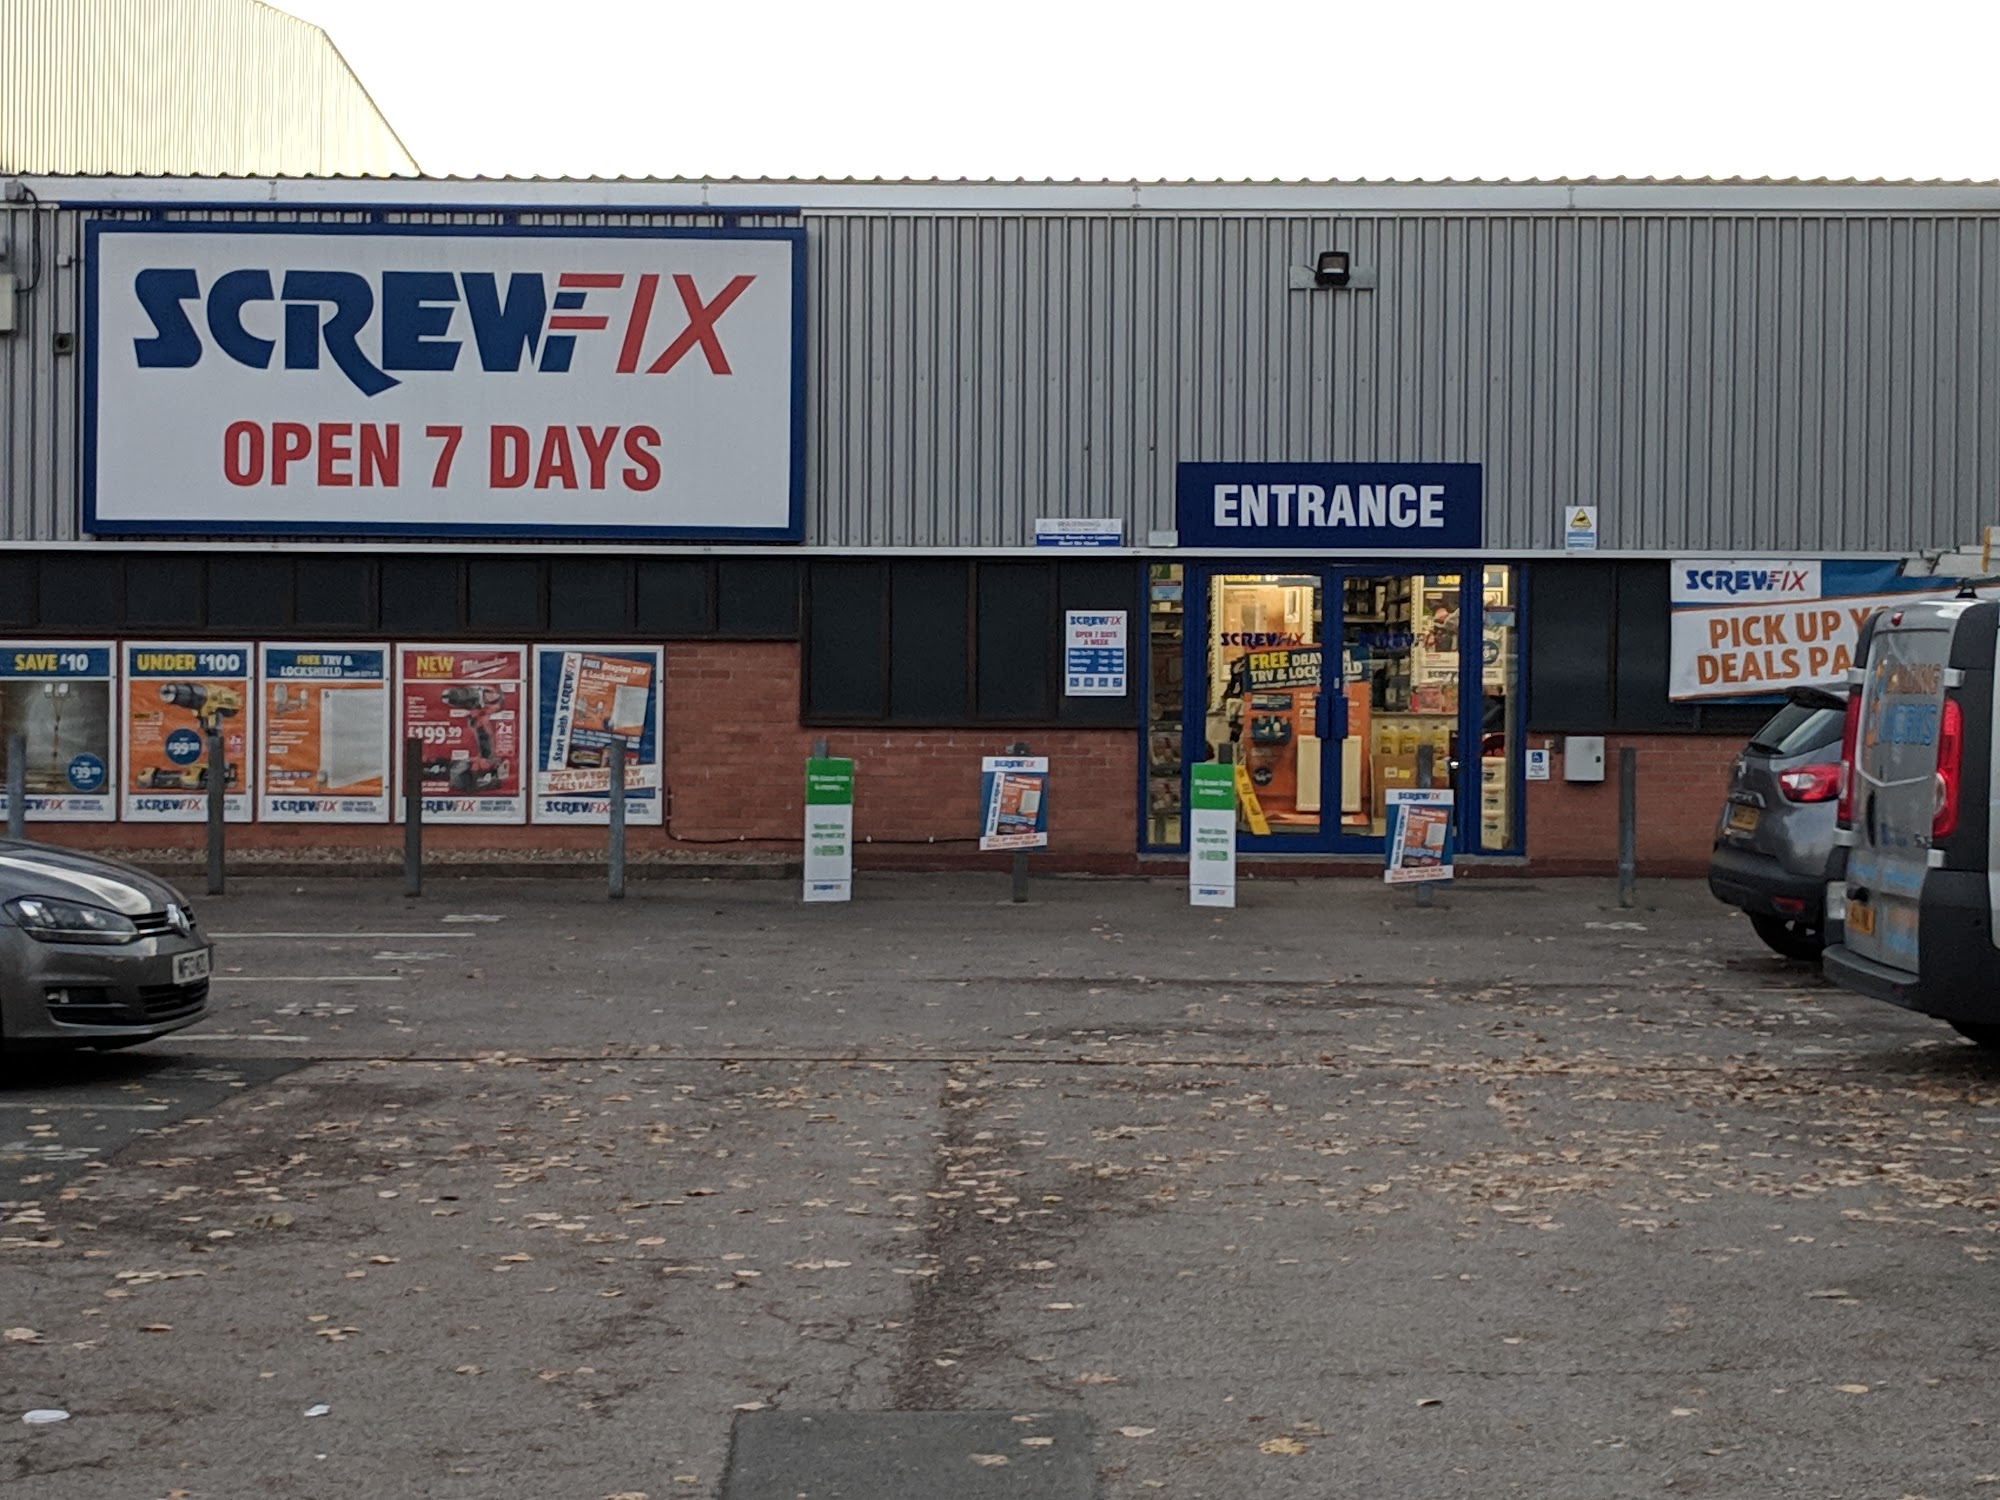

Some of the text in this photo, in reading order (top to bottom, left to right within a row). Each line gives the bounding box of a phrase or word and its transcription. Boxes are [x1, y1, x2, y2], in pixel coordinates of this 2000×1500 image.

[133, 268, 757, 397] SCREWFIX
[223, 420, 662, 492] OPEN 7 DAYS
[1213, 484, 1445, 528] ENTRANCE
[1686, 570, 1809, 595] SCREWFIX
[1070, 616, 1123, 627] SCREWFIX
[1709, 613, 1786, 649] PICK
[1795, 610, 1842, 643] UP
[1220, 632, 1305, 649] SCREWFIX
[14, 653, 89, 671] SAVE £10
[136, 653, 240, 672] UNDER £100
[296, 654, 321, 666] FREE
[416, 656, 454, 672] NEW
[1249, 651, 1290, 670] FREE
[1697, 644, 1851, 685] DEALS PA
[280, 666, 342, 677] LOCKSHIELD
[1250, 668, 1274, 683] TRV
[1276, 666, 1287, 680] &
[552, 654, 577, 763] Start with SCREWFIX
[136, 799, 202, 813] SCREWFIX
[271, 800, 337, 814] SCREWFIX
[545, 801, 610, 815] SCREWFIX
